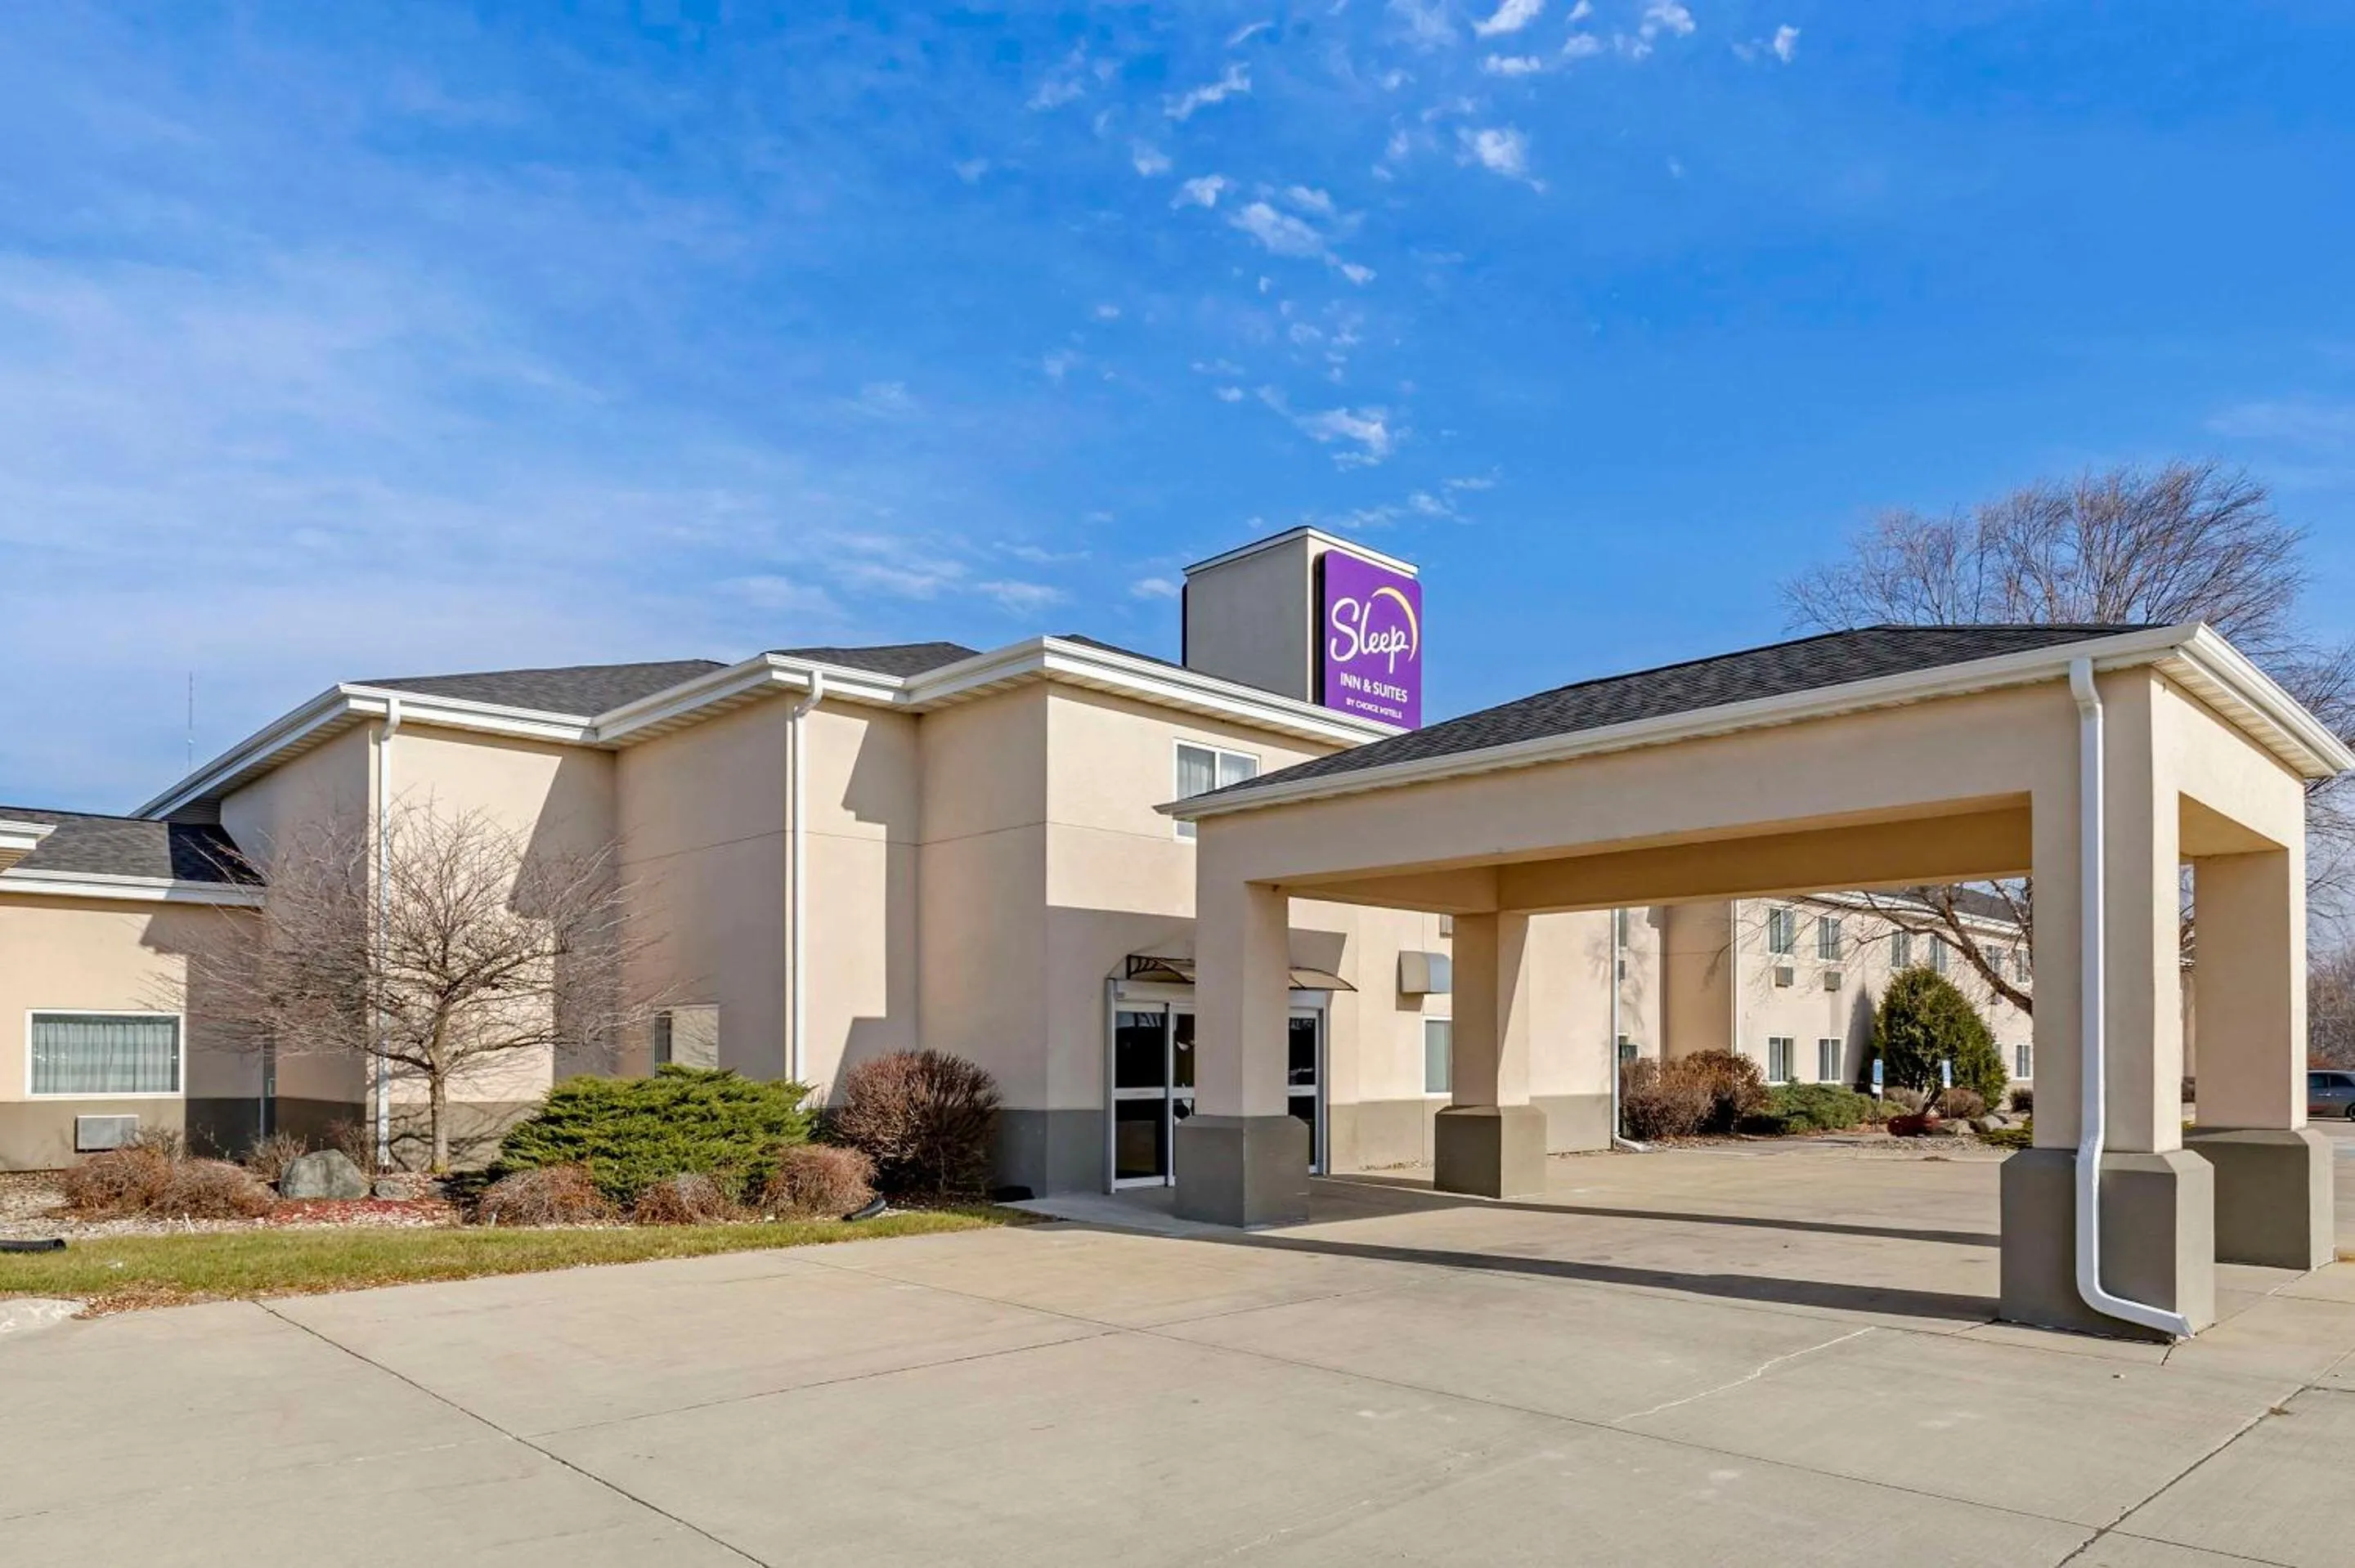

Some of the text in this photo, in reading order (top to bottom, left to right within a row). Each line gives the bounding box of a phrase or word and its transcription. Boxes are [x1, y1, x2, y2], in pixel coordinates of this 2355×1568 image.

[1330, 597, 1409, 674] Sleep
[1340, 671, 1407, 703] INN & SUITES
[1346, 697, 1402, 719] BY CHOICE HOTELS
